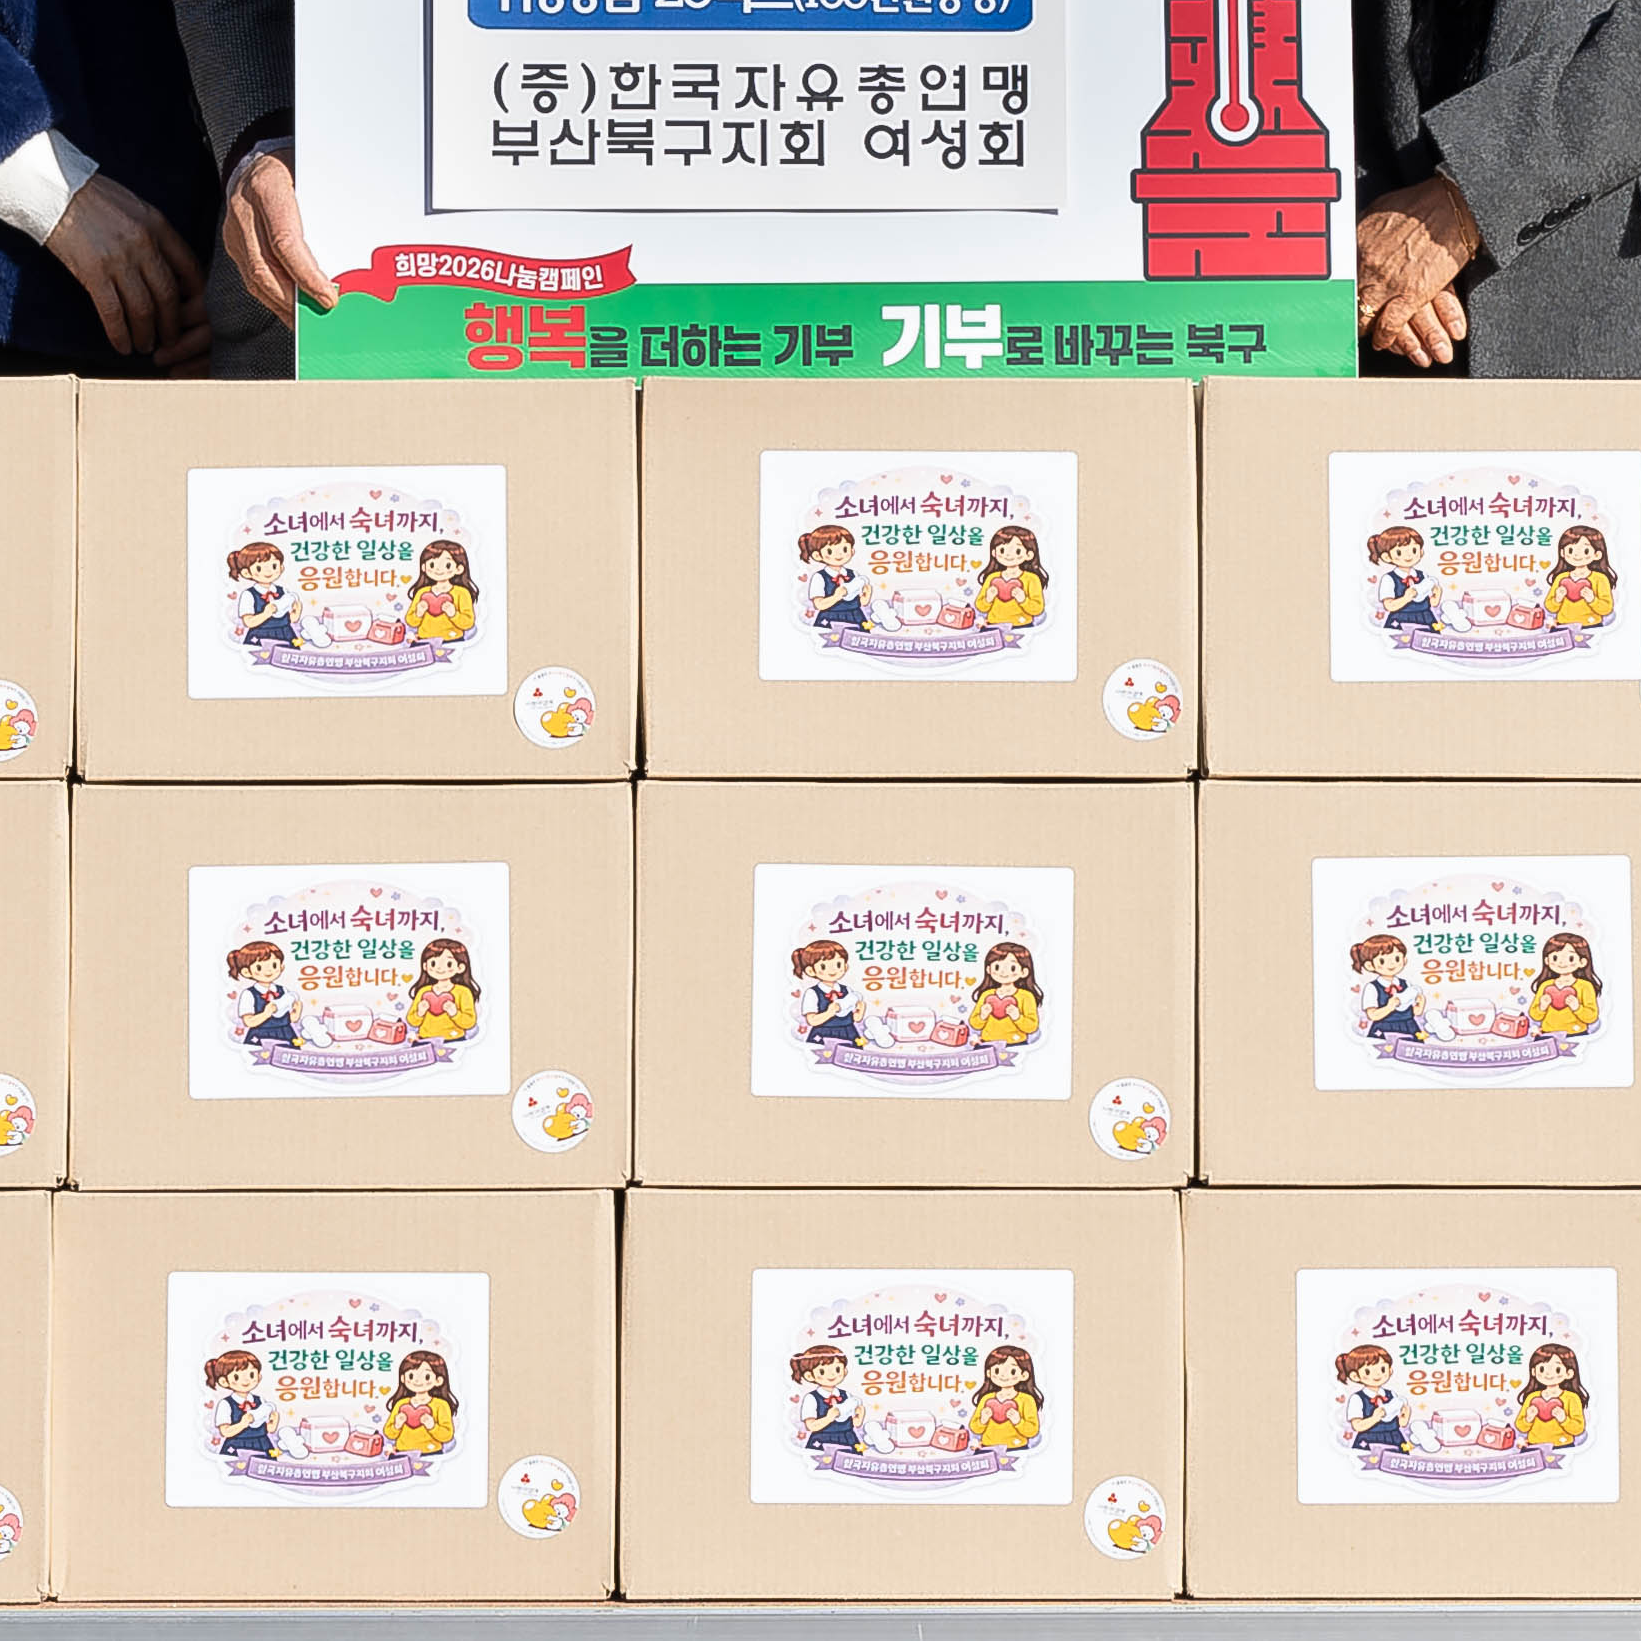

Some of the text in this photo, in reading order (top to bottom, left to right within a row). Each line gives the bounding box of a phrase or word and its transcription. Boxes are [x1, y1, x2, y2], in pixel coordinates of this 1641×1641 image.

[493, 62, 1029, 115] (증)한국자유총연맹
[492, 119, 1025, 169] 부산북구지회 여성회
[394, 253, 605, 292] 희망2026나눔캠페인
[463, 303, 1267, 371] 행복을 더하는 기부 기부로 바꾸는 북구
[834, 494, 916, 520] 소녀에서
[1403, 495, 1484, 521] 소녀에서
[263, 510, 345, 537] 소녀에서
[860, 524, 985, 546] 건강한 일상을
[1429, 524, 1553, 547] 건강한 일상을
[290, 539, 414, 562] 건강한 일상을
[263, 909, 346, 936] 소녀에서
[1386, 903, 1468, 929] 소녀에서
[290, 938, 415, 961] 건강한 일상을
[1413, 932, 1537, 955] 건강한 일상을
[827, 1313, 910, 1339] 소녀에서
[853, 1343, 979, 1366] 건강한 일상을
